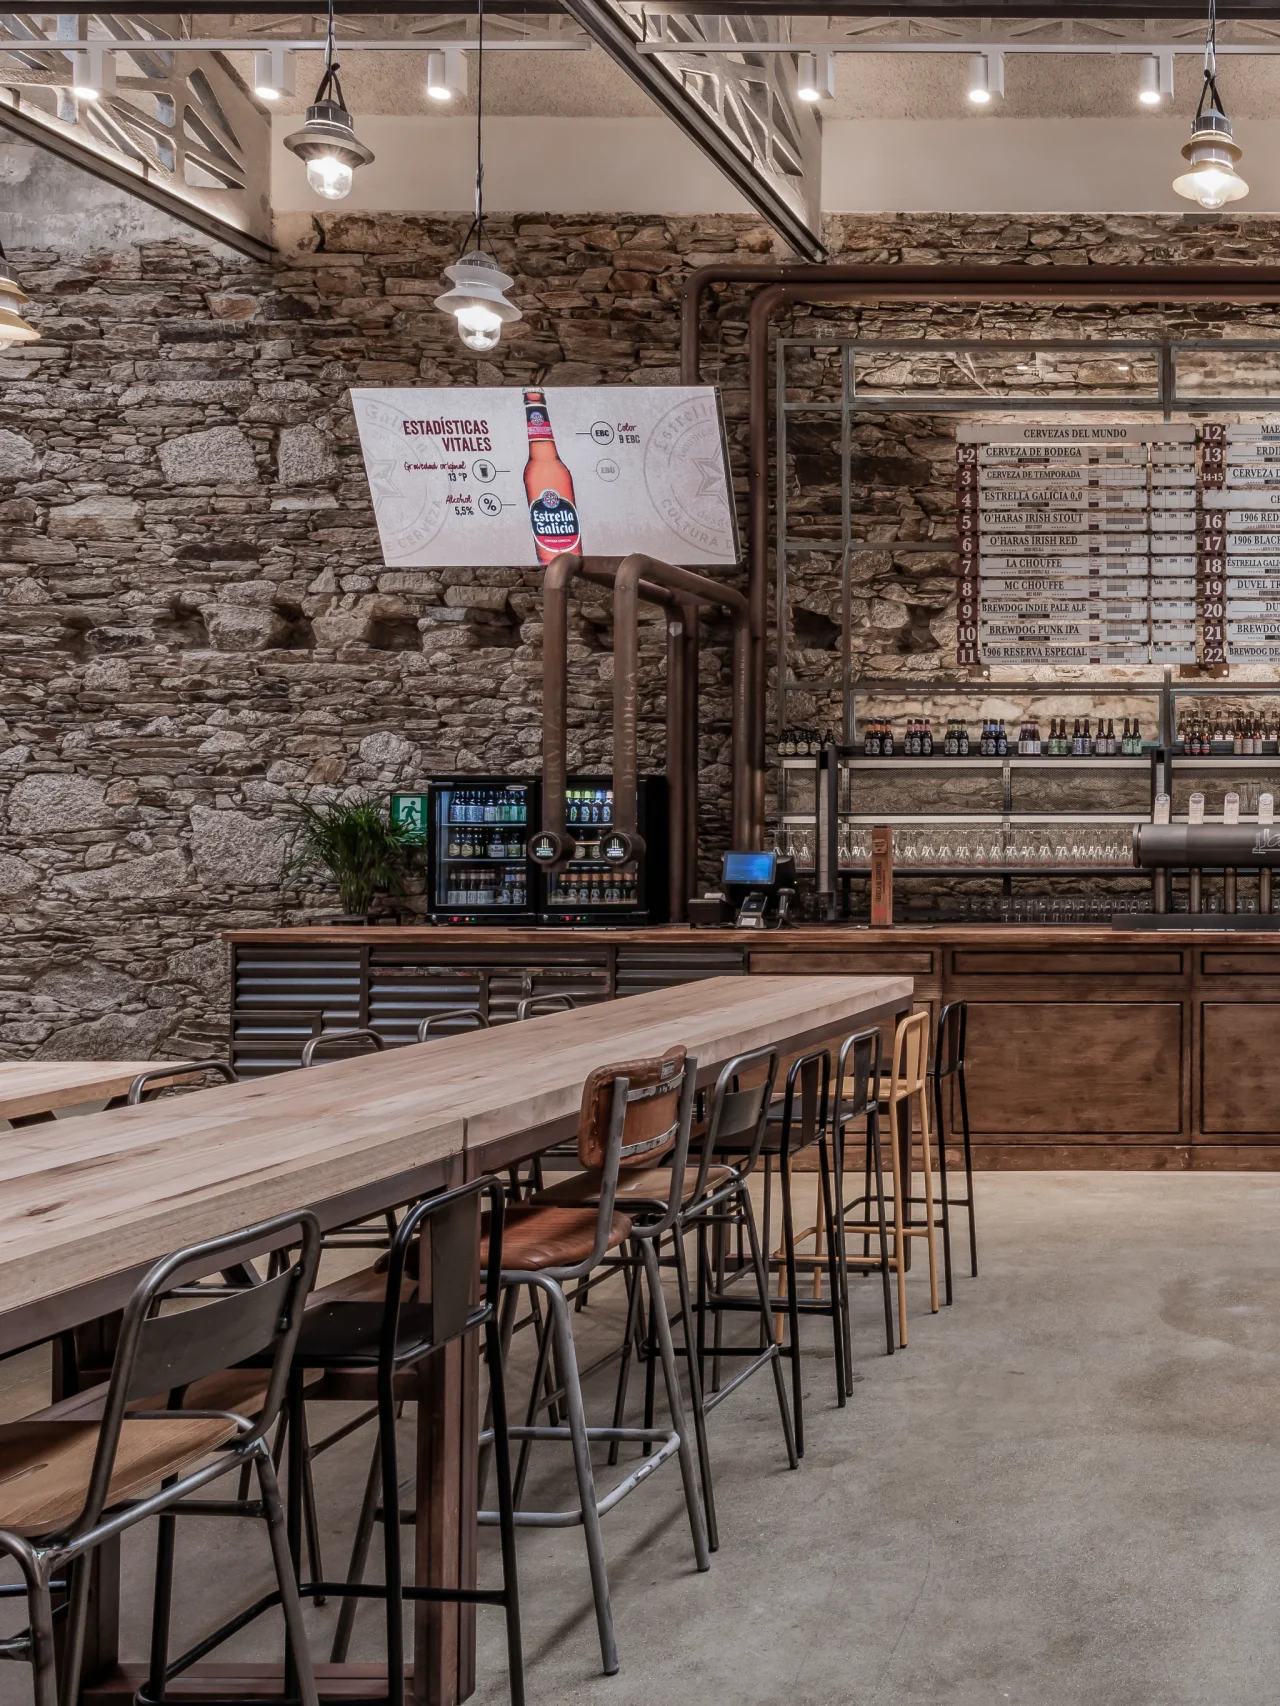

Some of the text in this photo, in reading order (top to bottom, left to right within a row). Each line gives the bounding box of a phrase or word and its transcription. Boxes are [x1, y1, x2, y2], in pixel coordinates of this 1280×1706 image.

[402, 416, 490, 435] ESTADÍSTICAS
[617, 423, 637, 432] Color
[619, 435, 640, 443] 9 EBC
[1024, 430, 1126, 438] CERVEZAS DEL MUNDO
[1204, 426, 1221, 440] 12
[442, 437, 492, 452] VITALES
[958, 449, 975, 462] 1-2
[986, 448, 1081, 456] CERVEZA DE BODEGA
[1204, 449, 1221, 462] 13
[448, 473, 457, 482] 13
[962, 472, 971, 485] 3
[1233, 469, 1273, 477] CERVEZA
[446, 494, 472, 504] Alcohol
[962, 494, 971, 507] 4
[985, 492, 1029, 500] ESTRELLA
[1032, 492, 1068, 500] GALICIA
[454, 506, 474, 516] 5,5%
[533, 510, 574, 522] Estrella
[963, 516, 971, 529] 5
[985, 514, 1083, 522] O'HARAS IRISH STOUT
[1205, 515, 1222, 528] 16
[536, 522, 574, 534] Galicia
[963, 538, 971, 551] 6
[990, 537, 1077, 545] O'HARAS IRISH RED
[1205, 537, 1221, 550] 17
[1234, 536, 1251, 544] 1906
[962, 561, 971, 574] 7
[1006, 559, 1062, 567] LA CHOUFFE
[1205, 559, 1221, 572] 18
[963, 583, 972, 596] 8
[1005, 581, 1064, 589] MC CHOUFFE
[1205, 582, 1221, 594] 19
[1238, 580, 1267, 588] DUVEL
[963, 605, 972, 618] 9
[1204, 604, 1222, 617] 20
[959, 627, 976, 640] 10
[1205, 627, 1222, 640] 21
[960, 650, 975, 663] 11
[983, 648, 1087, 656] 1906 RESERVA ESPECIAL
[1205, 649, 1222, 661] 22
